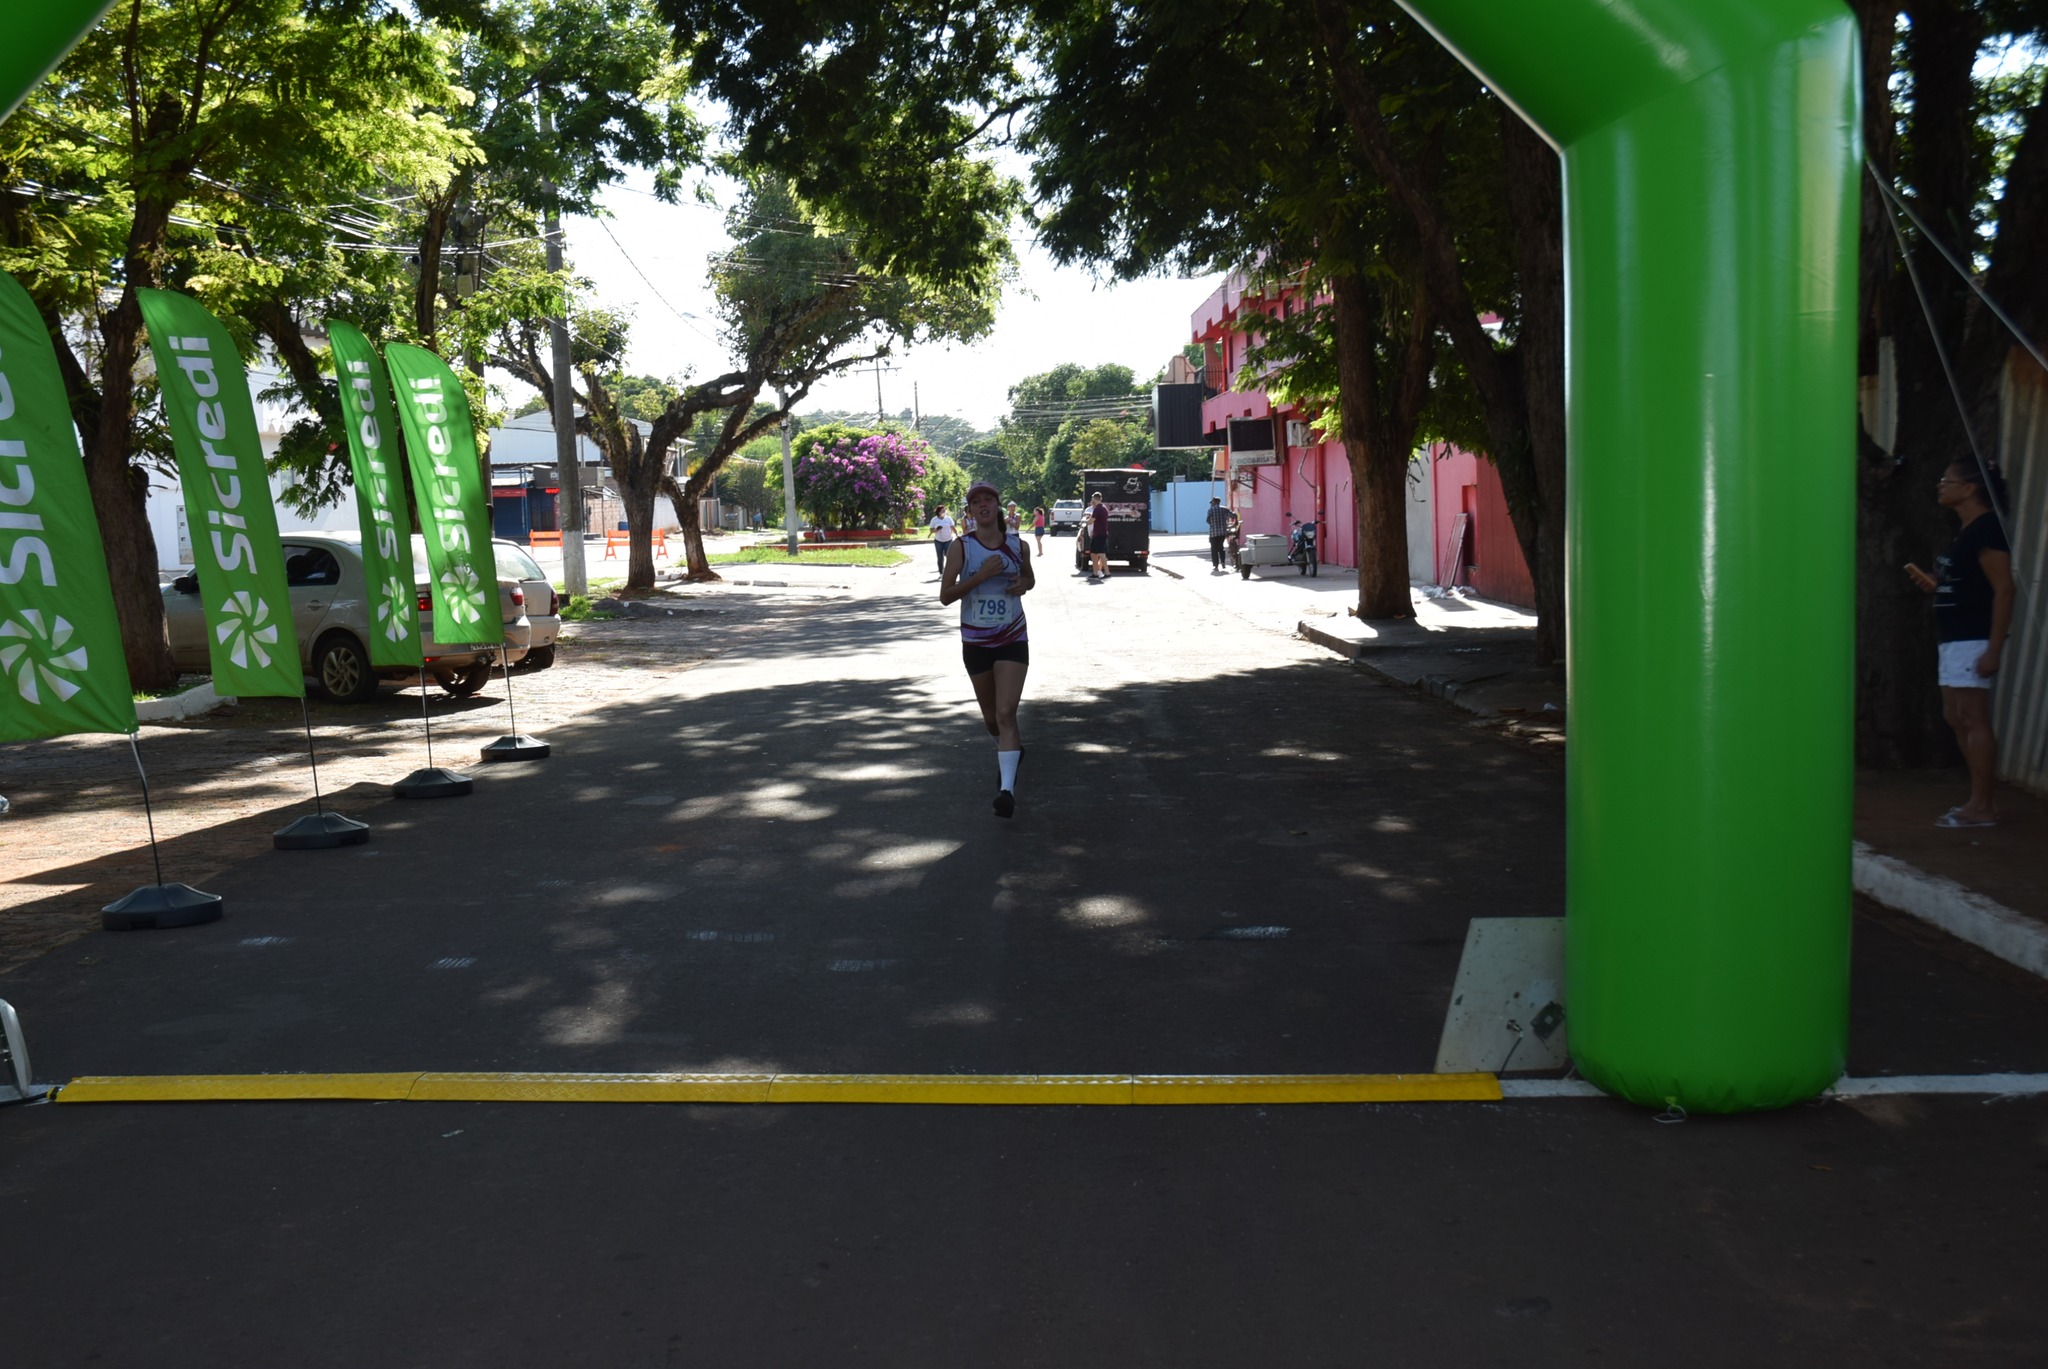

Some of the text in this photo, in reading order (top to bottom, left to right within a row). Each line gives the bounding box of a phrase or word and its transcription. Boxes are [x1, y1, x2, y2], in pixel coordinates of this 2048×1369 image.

[168, 336, 257, 575] Sicredi
[346, 360, 399, 562] Sicredi
[408, 374, 471, 554] Sicredi
[978, 599, 1006, 616] 798
